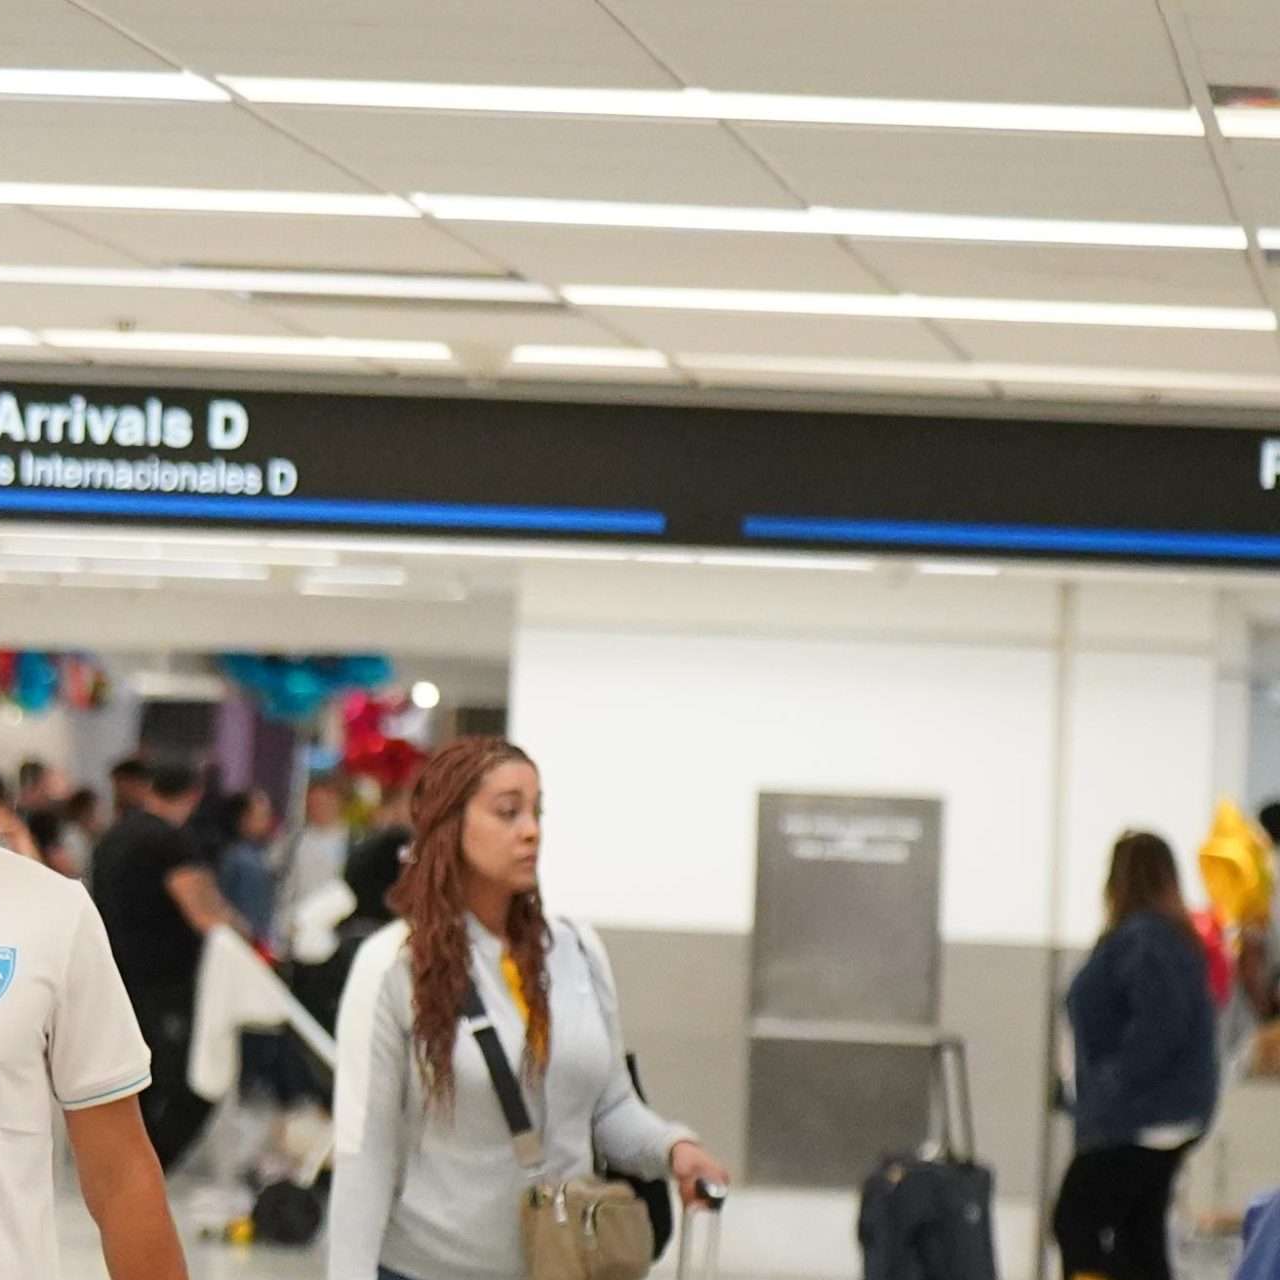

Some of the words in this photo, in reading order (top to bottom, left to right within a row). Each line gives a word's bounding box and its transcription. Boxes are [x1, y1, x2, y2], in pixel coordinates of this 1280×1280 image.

[207, 399, 250, 450] D
[19, 450, 263, 495] Internacionales
[267, 457, 299, 496] D
